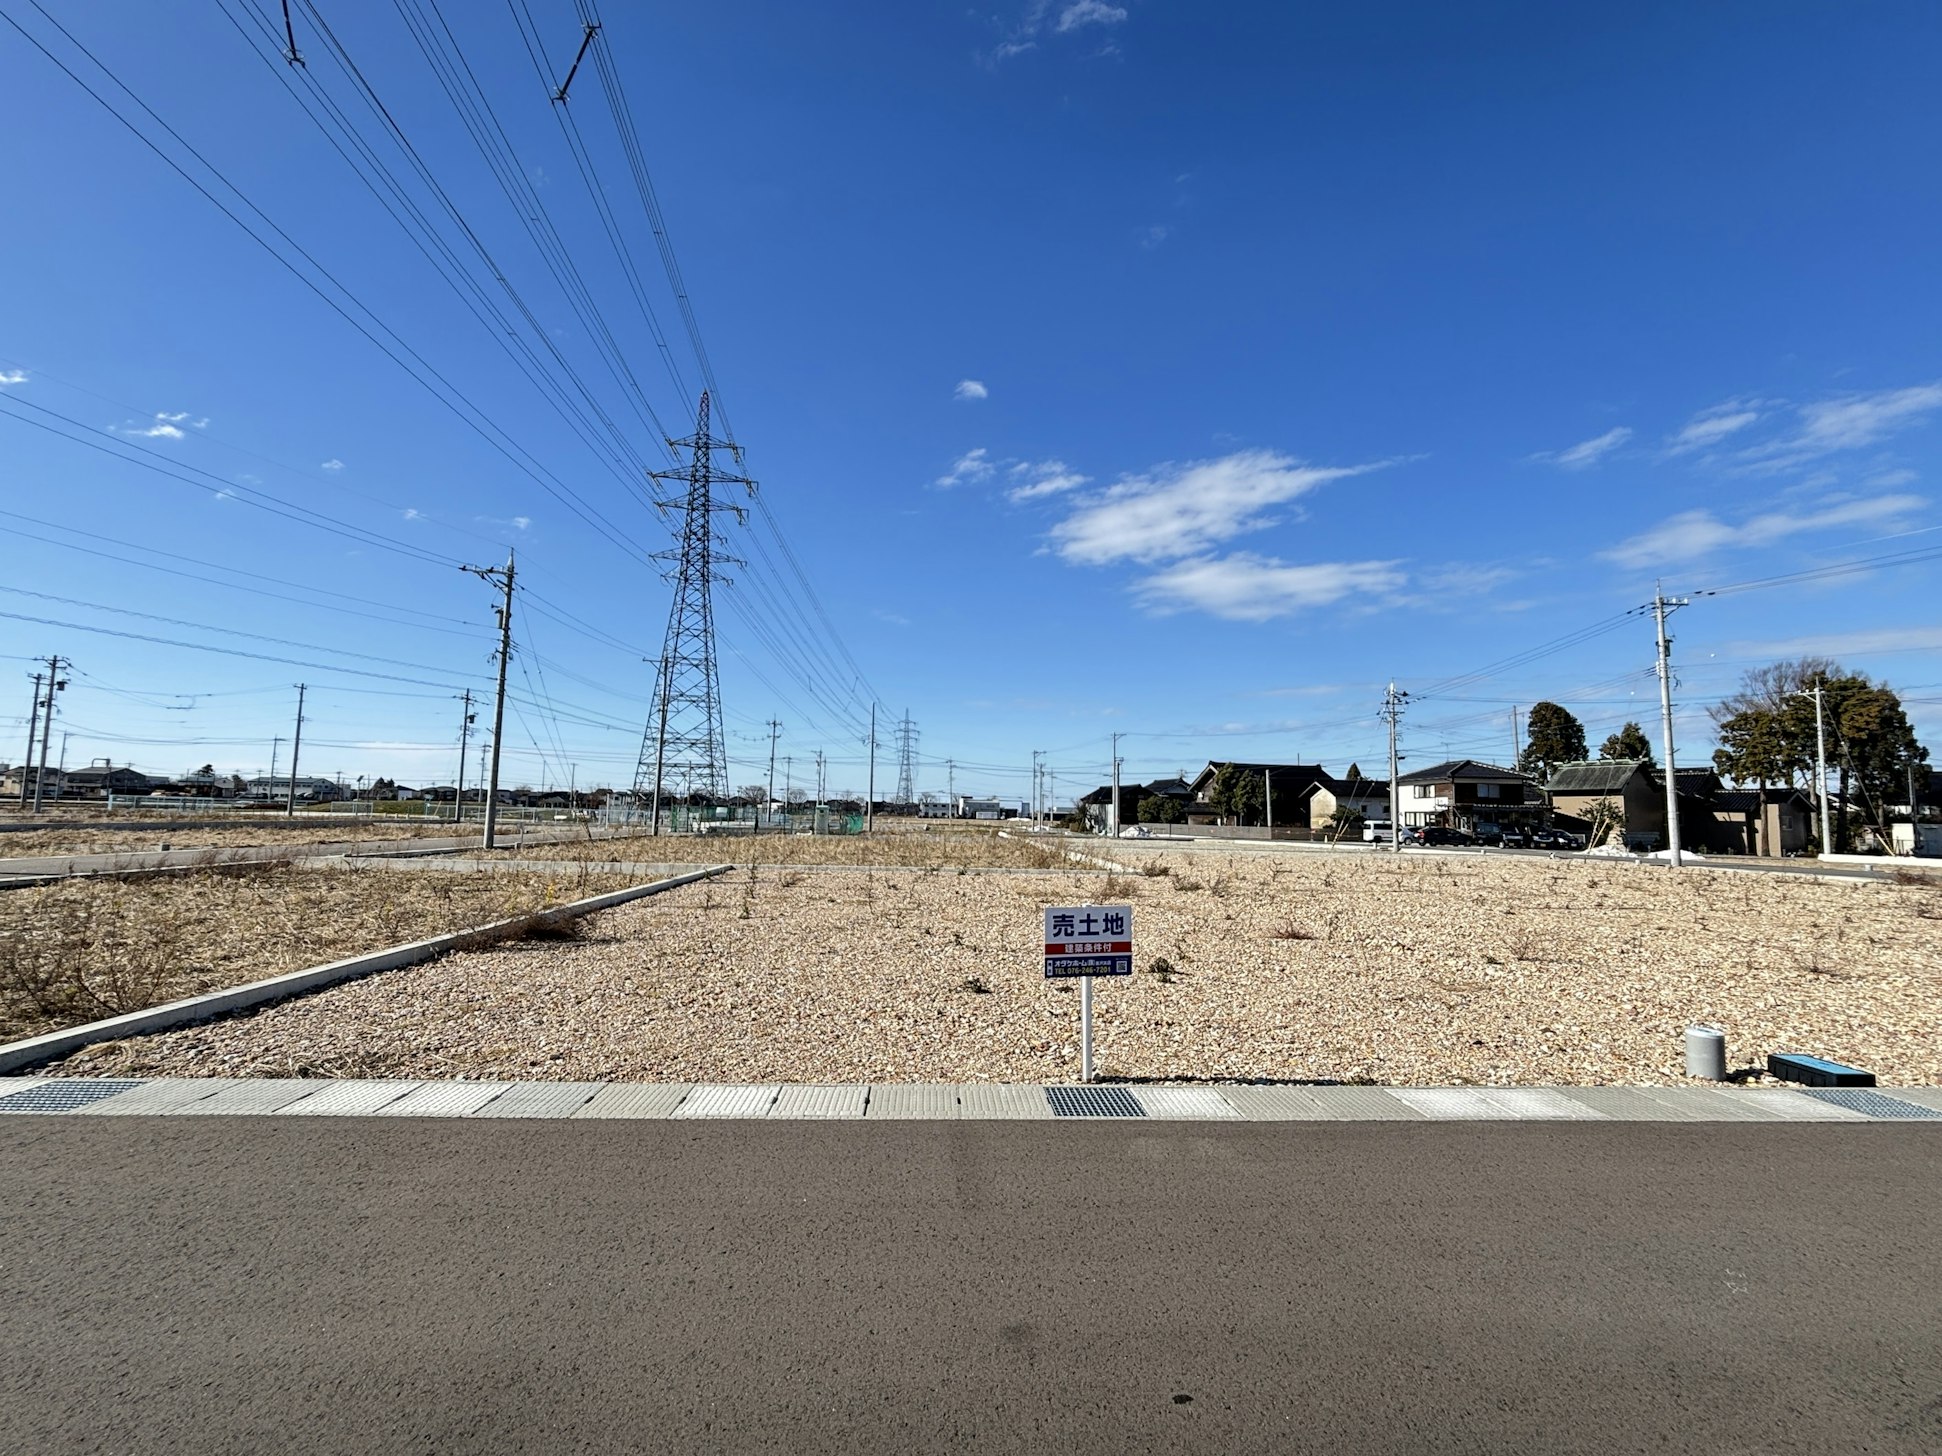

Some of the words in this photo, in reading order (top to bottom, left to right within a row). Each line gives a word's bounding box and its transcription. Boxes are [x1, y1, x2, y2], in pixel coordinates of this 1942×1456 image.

[1053, 912, 1124, 937] 売土地
[1065, 943, 1112, 953] 建築条件付
